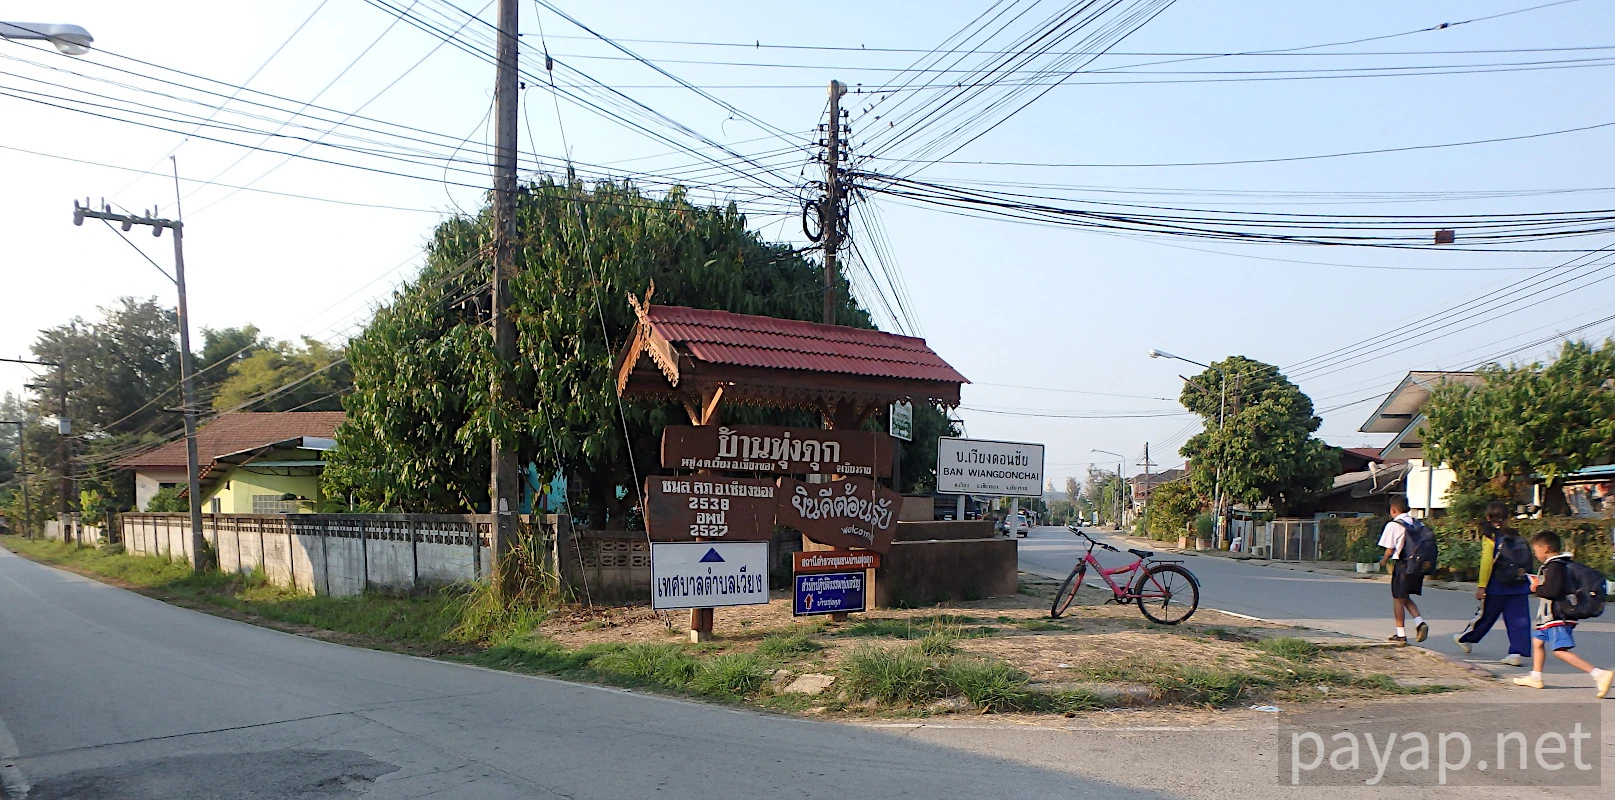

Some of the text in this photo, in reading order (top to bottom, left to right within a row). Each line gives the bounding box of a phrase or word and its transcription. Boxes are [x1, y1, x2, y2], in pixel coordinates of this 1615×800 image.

[956, 448, 1029, 466] บ.เวียงดอนชัย
[943, 467, 1039, 480] BAN WIANGDONCHAI
[688, 497, 730, 510] 2538
[791, 482, 893, 530] ยินดีต้อนรับ
[689, 524, 729, 537] 2527
[658, 565, 762, 597] เทศบาลตำบลเวียง
